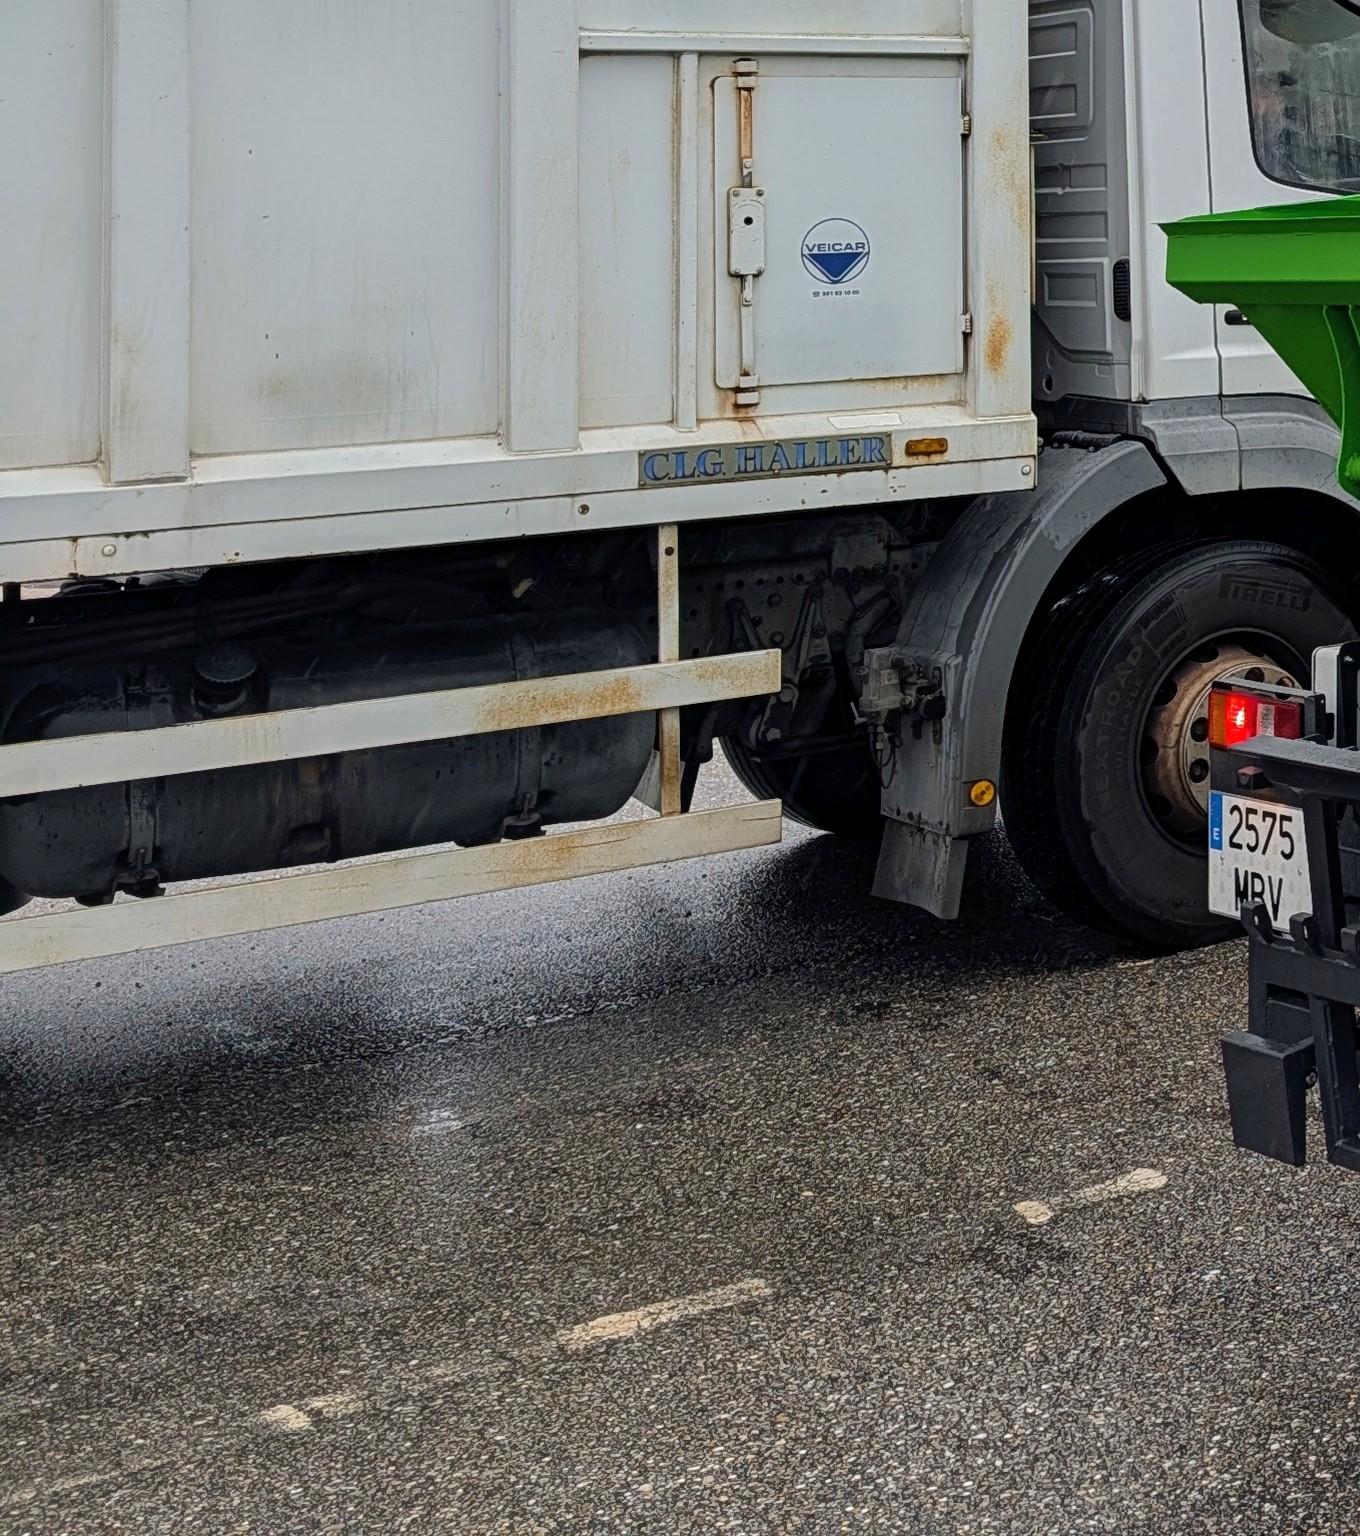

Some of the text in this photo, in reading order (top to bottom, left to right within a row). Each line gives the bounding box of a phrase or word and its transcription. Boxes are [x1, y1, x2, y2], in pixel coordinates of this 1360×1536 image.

[805, 242, 866, 252] VEICAR
[734, 436, 888, 475] HALLER
[1218, 573, 1312, 612] PIRELLI
[1212, 827, 1220, 841] E
[1228, 804, 1295, 860] 2575
[1234, 867, 1283, 922] MRV
